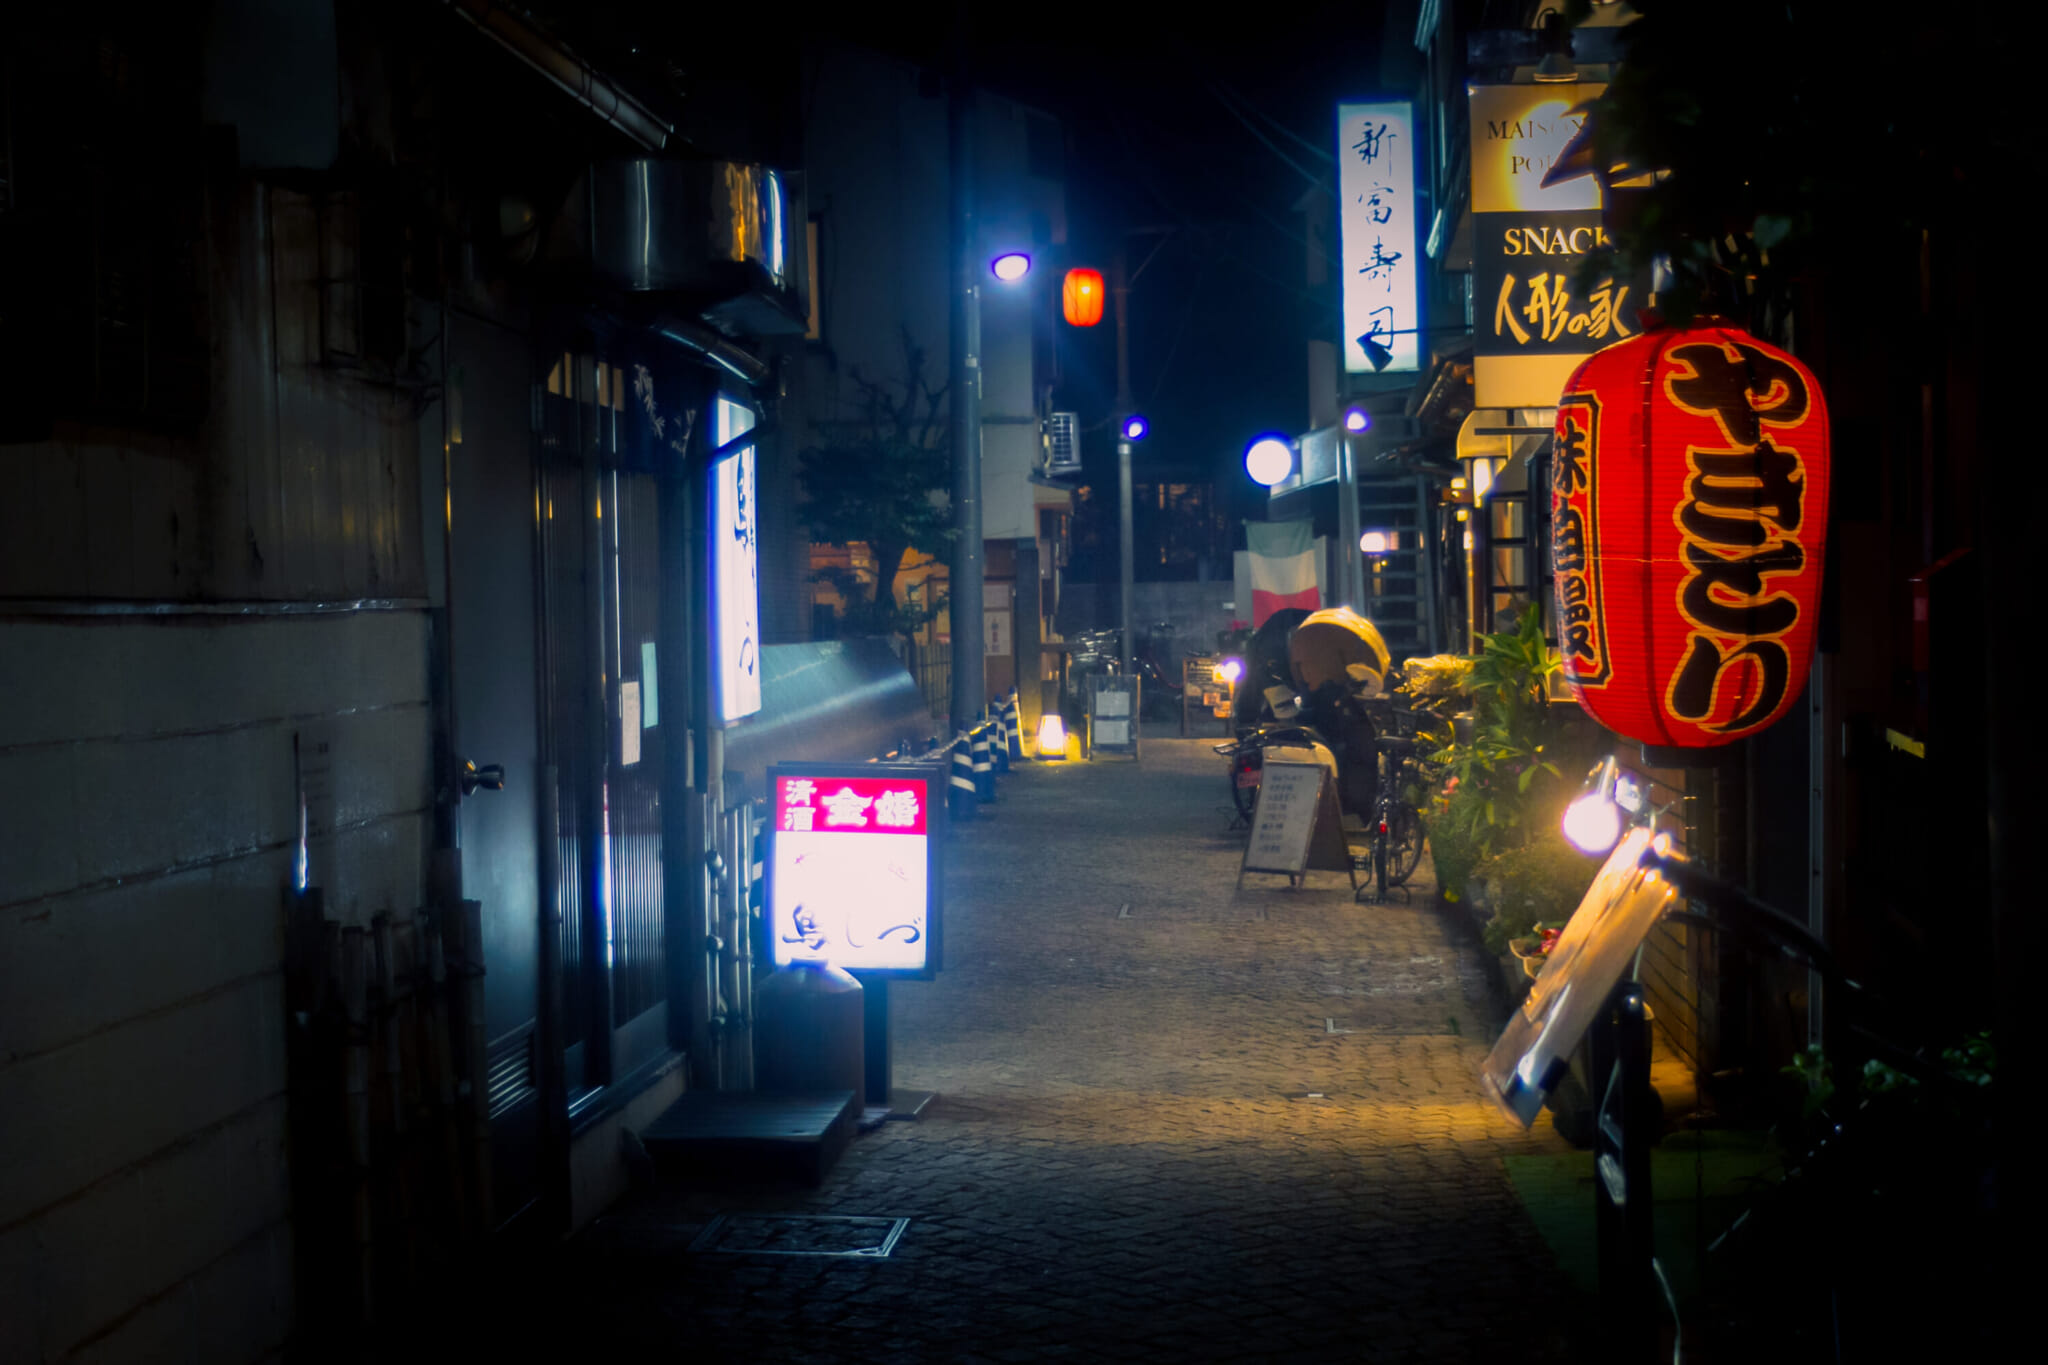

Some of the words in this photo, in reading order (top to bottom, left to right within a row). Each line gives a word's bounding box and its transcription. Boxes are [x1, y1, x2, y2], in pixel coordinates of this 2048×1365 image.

[1503, 227, 1612, 256] SNACK
[1494, 272, 1631, 345] 人形の家
[1662, 341, 1811, 735] やきとり
[784, 779, 818, 831] 清酒
